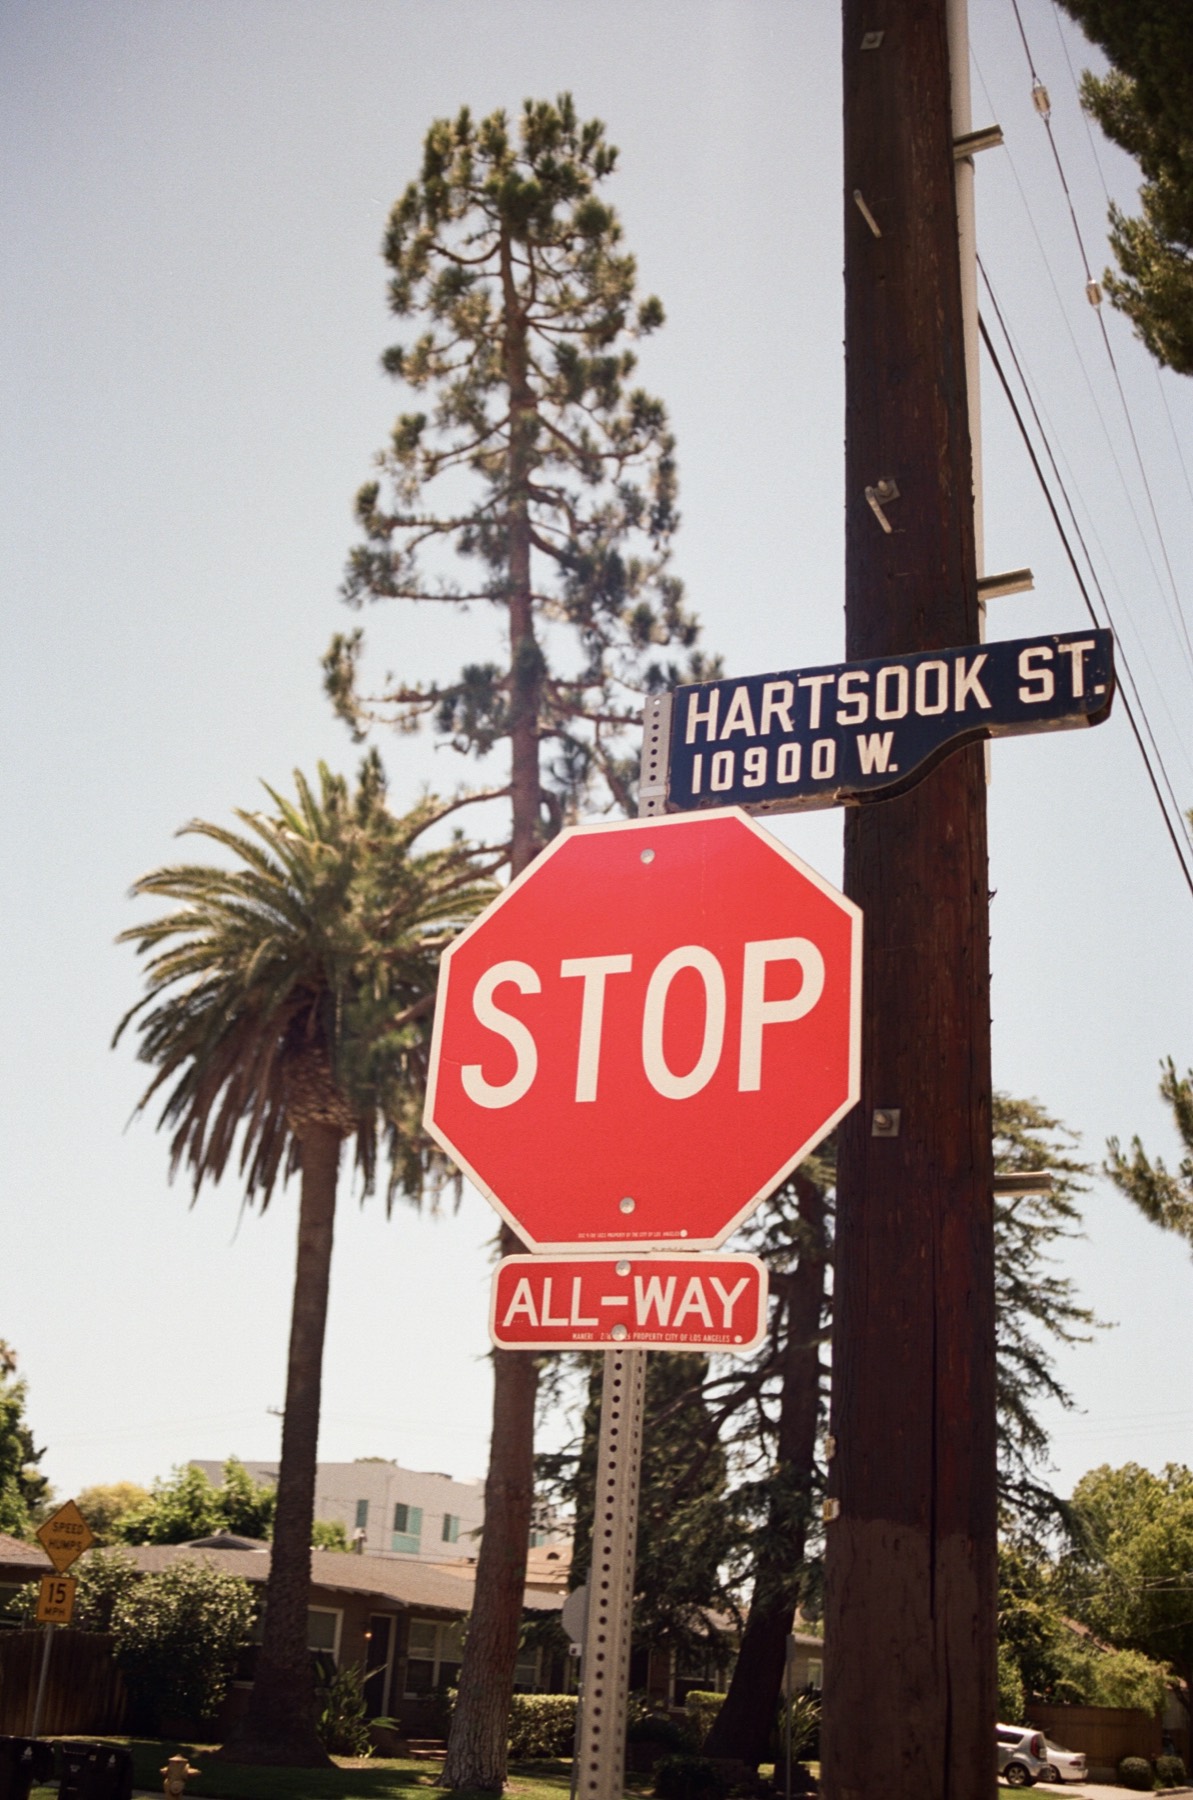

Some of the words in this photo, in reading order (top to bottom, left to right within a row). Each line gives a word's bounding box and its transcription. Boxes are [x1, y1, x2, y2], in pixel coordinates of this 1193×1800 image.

[685, 653, 992, 745] HARTSOOK
[1017, 639, 1106, 704] ST.
[691, 737, 836, 795] 10900
[856, 730, 899, 775] W.
[460, 936, 826, 1109] STOP
[502, 1275, 750, 1328] ALL-WAY
[633, 1332, 663, 1341] PROPERTY
[665, 1333, 678, 1341] CITY
[680, 1333, 687, 1341] OF
[689, 1334, 701, 1342] LOS
[703, 1334, 730, 1343] ANGELES
[52, 1521, 84, 1535] SPEED
[48, 1538, 82, 1552] HUMPS
[48, 1582, 66, 1604] 15
[44, 1606, 66, 1617] MPH
